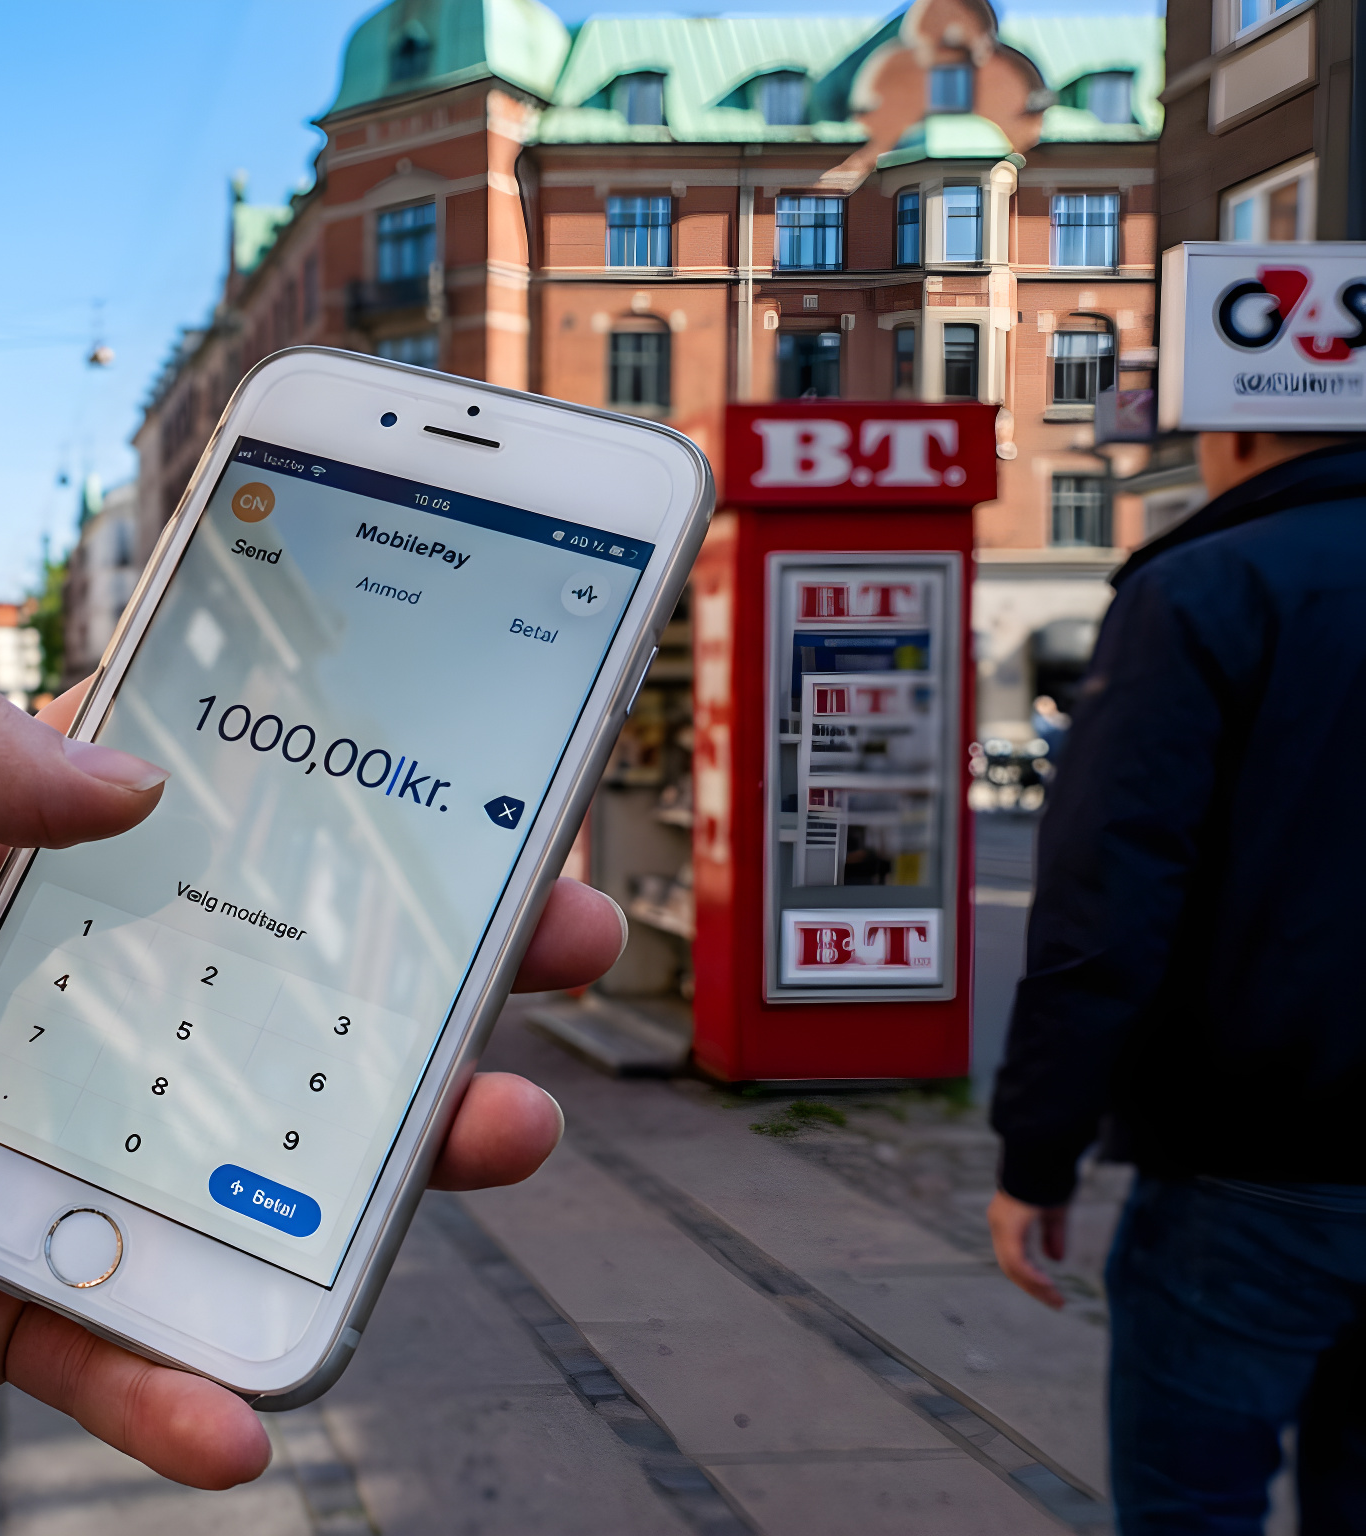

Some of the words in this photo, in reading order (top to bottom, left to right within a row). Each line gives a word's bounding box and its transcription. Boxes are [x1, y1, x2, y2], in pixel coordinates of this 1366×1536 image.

[750, 418, 967, 488] B.T.
[355, 522, 471, 570] MobilePay
[355, 577, 422, 604] Anmod
[509, 618, 559, 643] Betal
[82, 919, 93, 937] 1
[54, 974, 70, 992] 4
[201, 965, 219, 986] 2
[28, 1025, 45, 1043] 7
[176, 1020, 193, 1041] 5
[333, 1016, 351, 1036] 3
[151, 1076, 169, 1096] 8
[309, 1072, 327, 1092] 6
[124, 1133, 142, 1153] 0
[282, 1130, 300, 1150] 9
